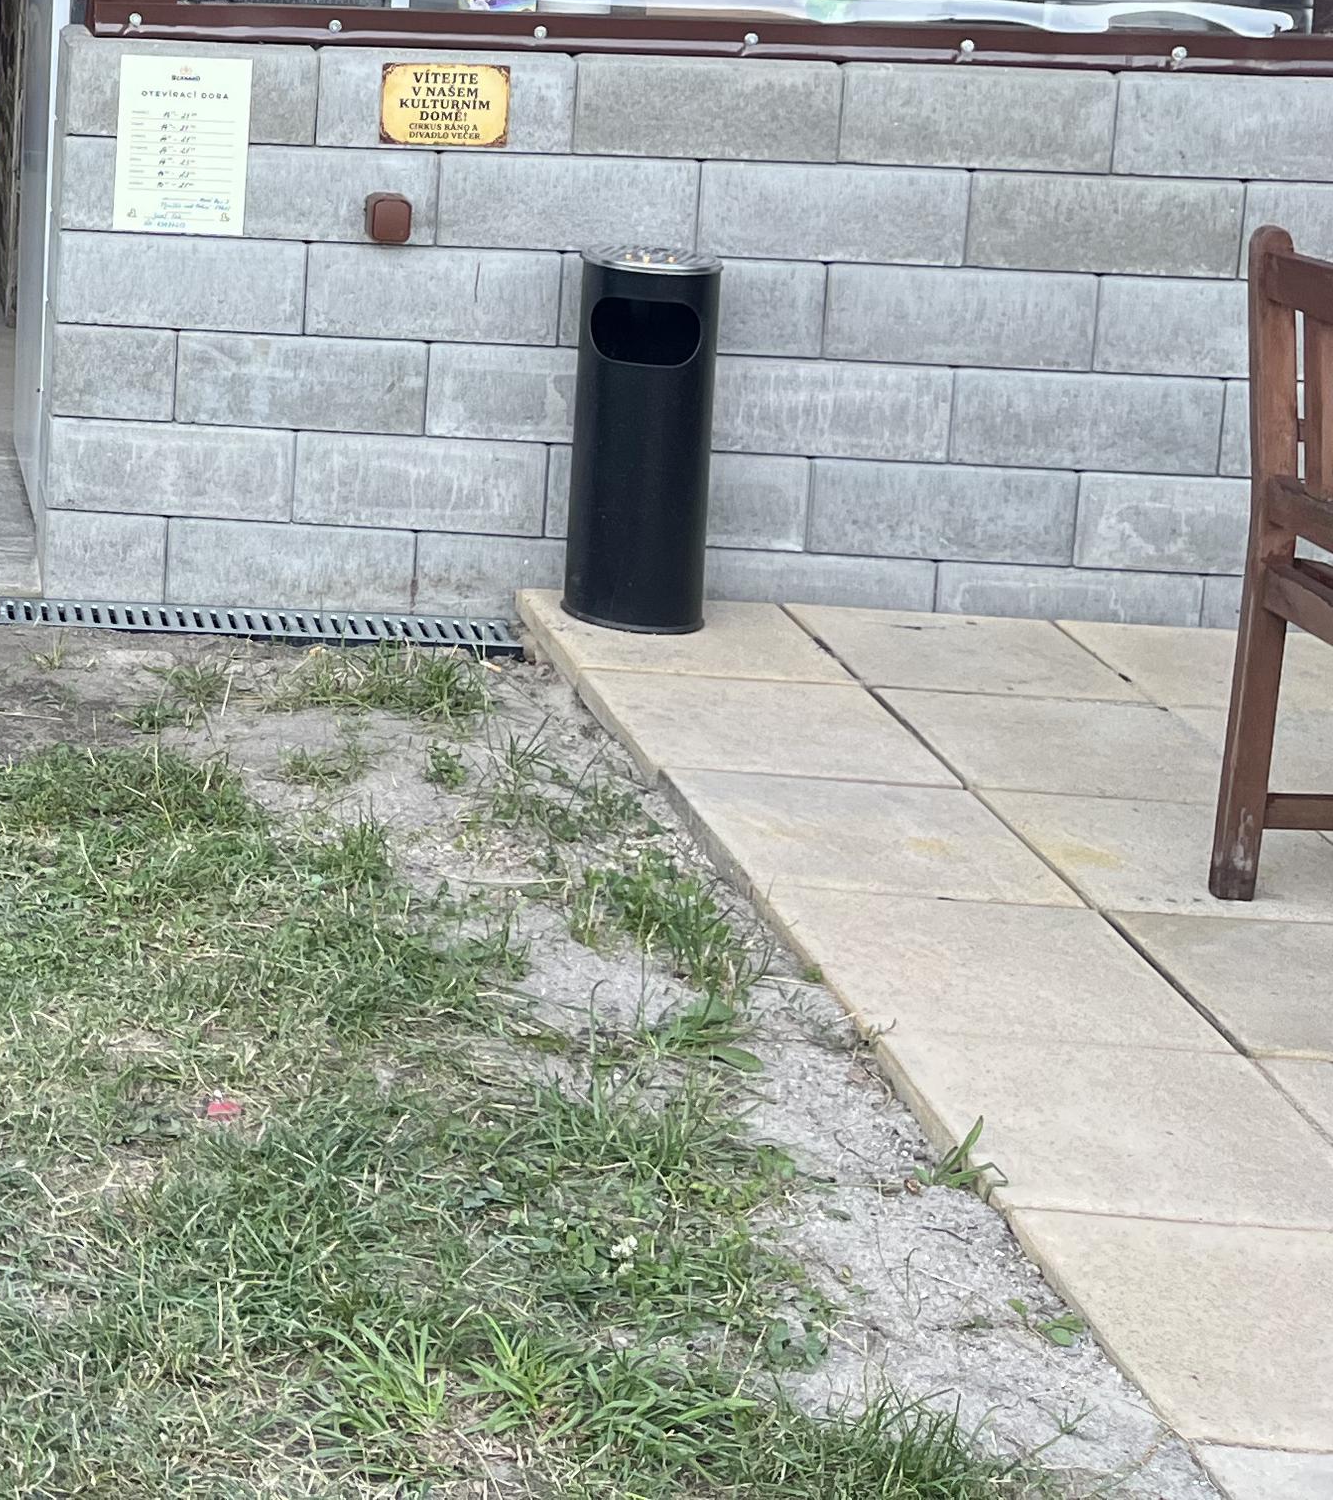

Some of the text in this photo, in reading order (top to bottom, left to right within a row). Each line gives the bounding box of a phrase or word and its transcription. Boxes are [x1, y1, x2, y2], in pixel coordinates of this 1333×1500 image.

[413, 69, 478, 85] VÍTEJTE
[141, 90, 197, 99] OTEVÍRACÍ
[412, 85, 479, 98] V NAŠEM
[399, 98, 491, 110] KULTURNÍM
[419, 109, 467, 121] DOMĚ!
[409, 123, 442, 131] CIRKUS
[409, 131, 449, 139] DIVADLO
